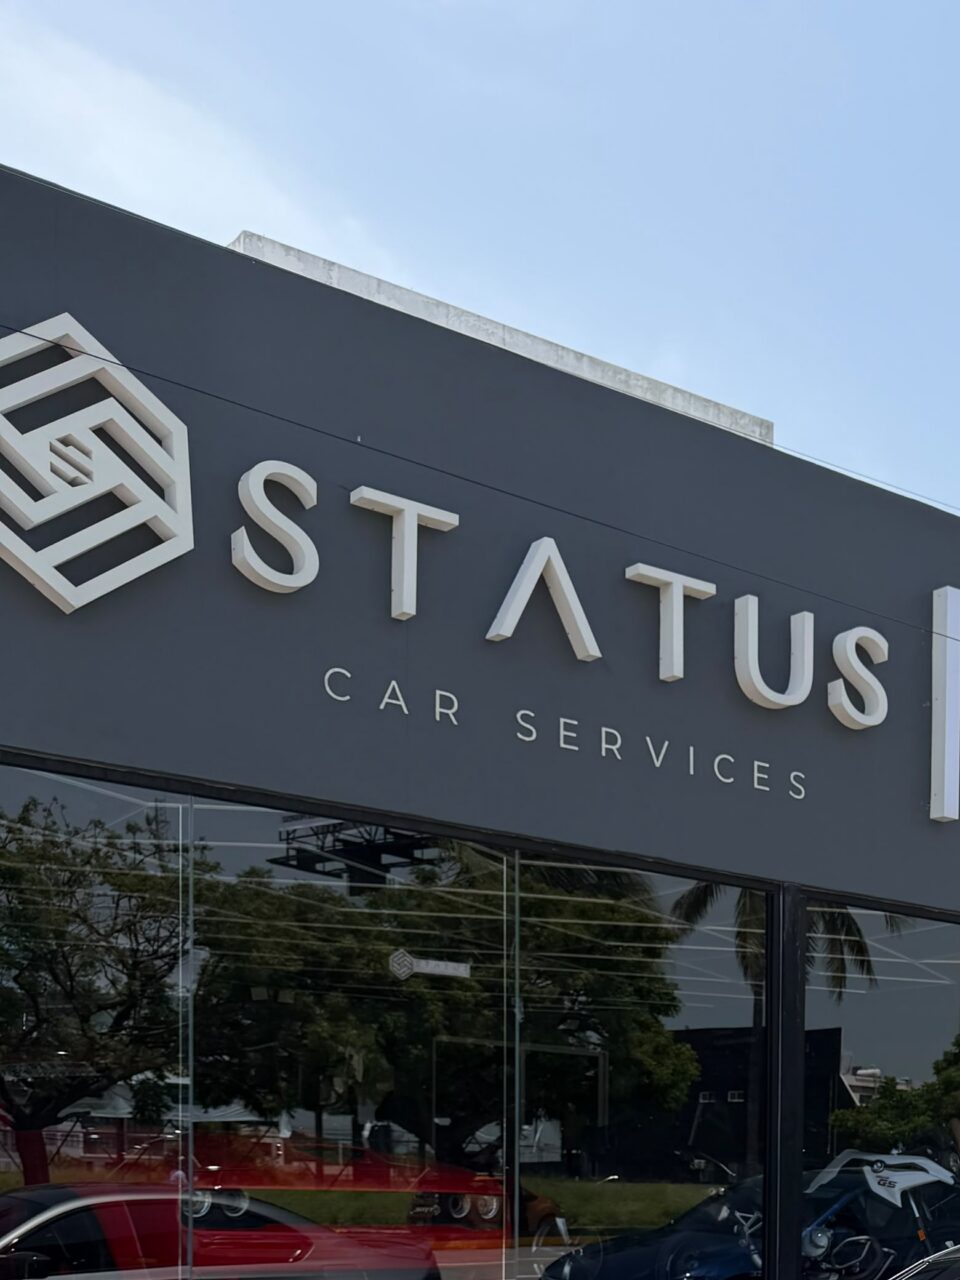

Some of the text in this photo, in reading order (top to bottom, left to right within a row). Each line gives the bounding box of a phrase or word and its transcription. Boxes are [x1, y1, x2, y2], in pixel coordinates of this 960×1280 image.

[231, 459, 889, 730] STATUS
[323, 666, 807, 800] CAR SERVICES
